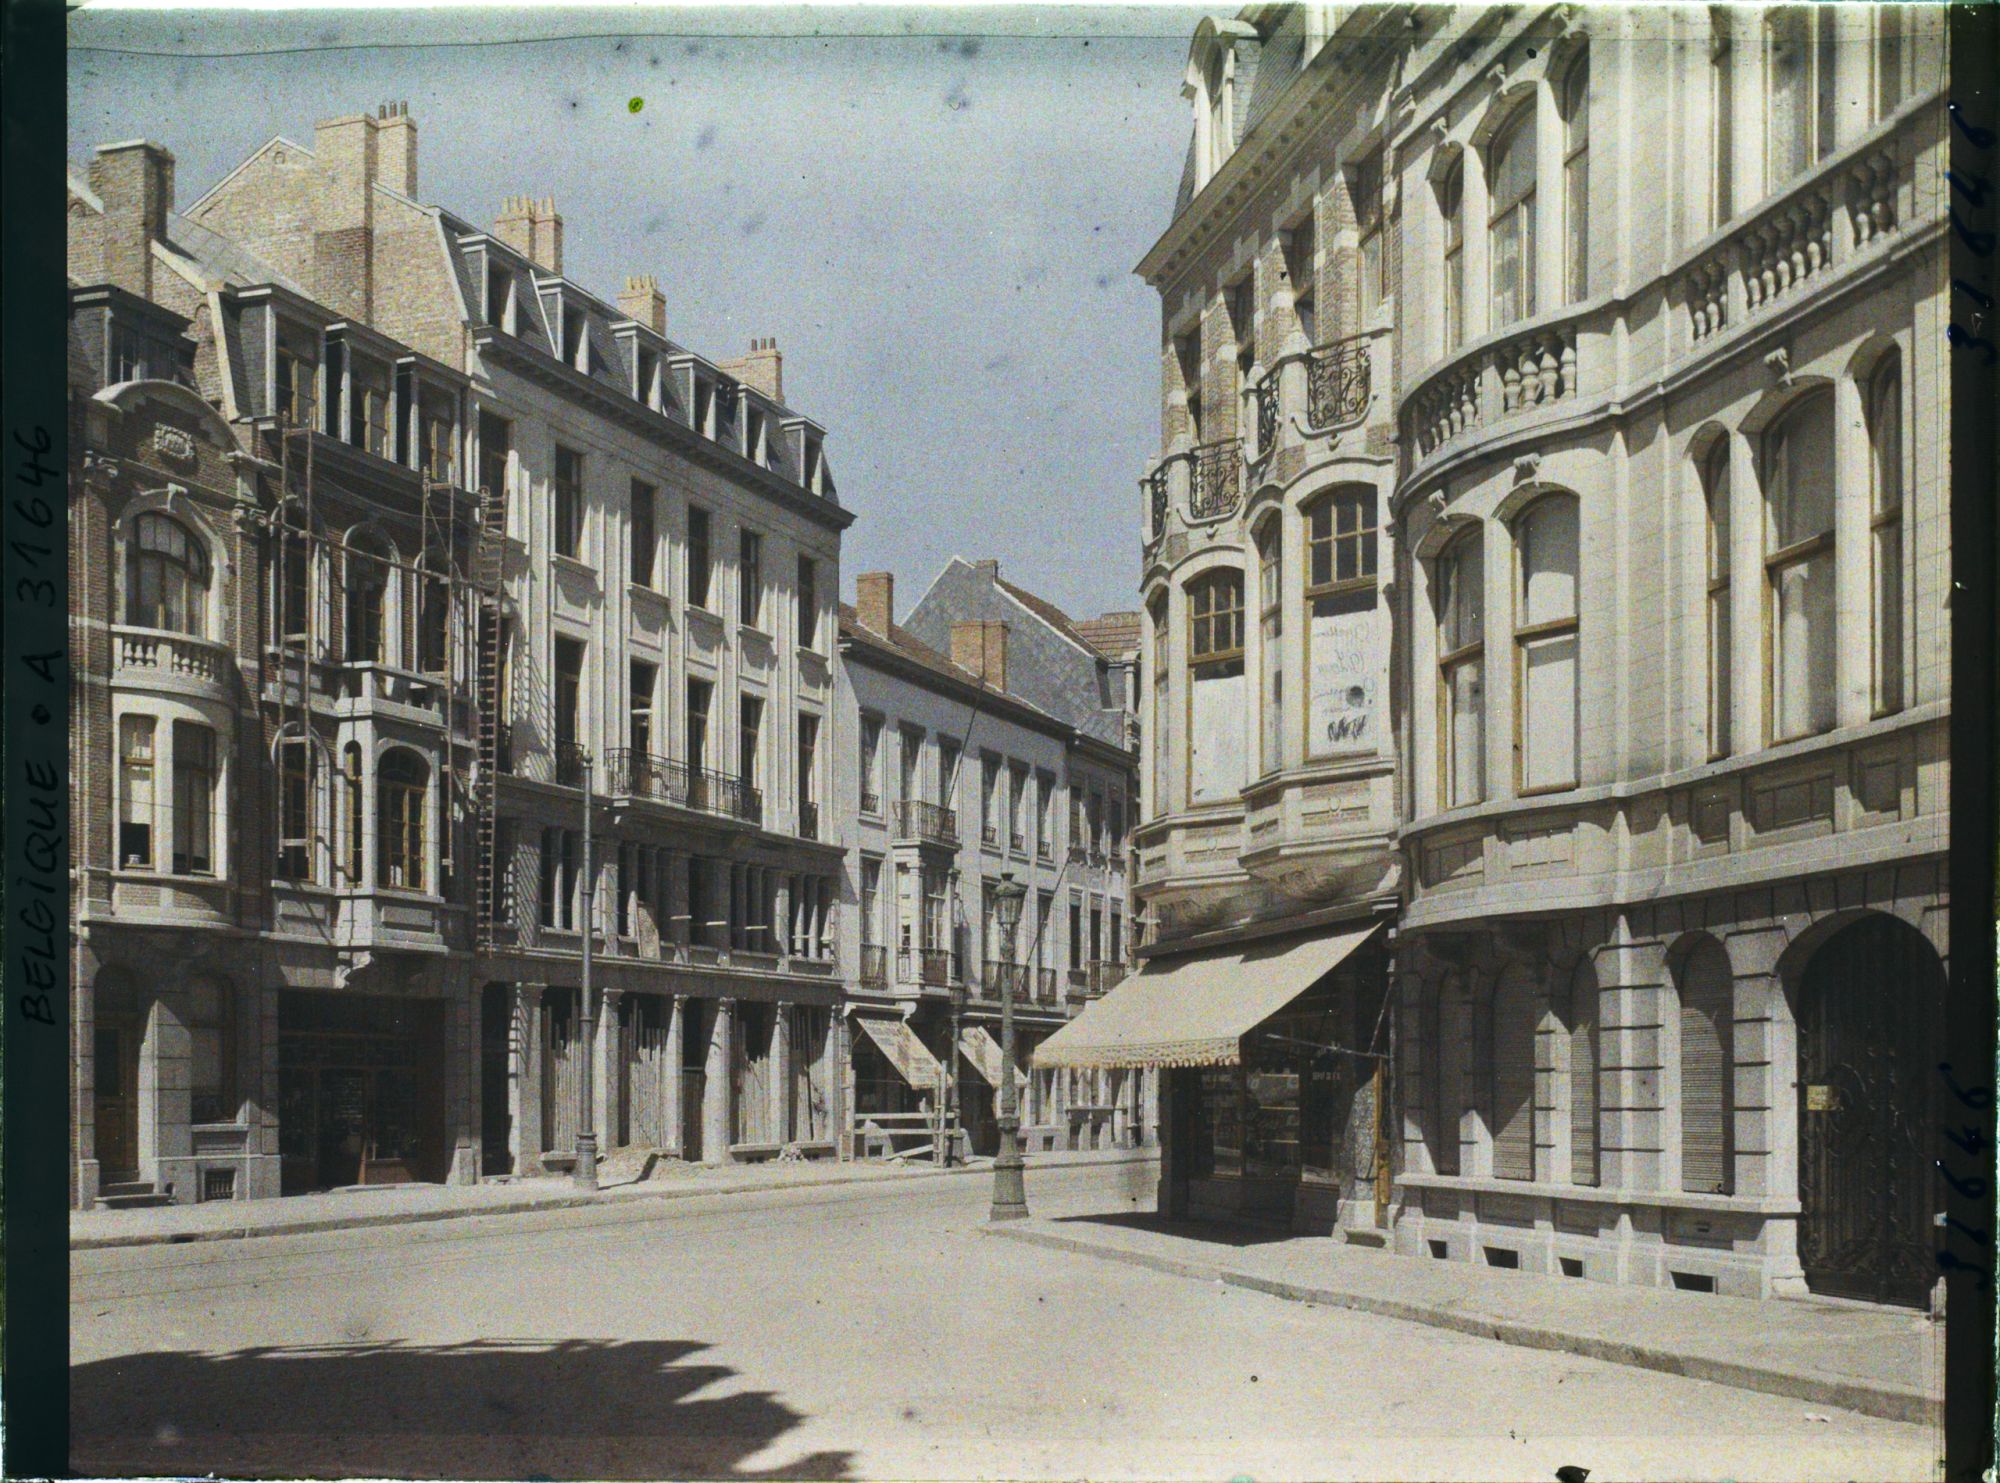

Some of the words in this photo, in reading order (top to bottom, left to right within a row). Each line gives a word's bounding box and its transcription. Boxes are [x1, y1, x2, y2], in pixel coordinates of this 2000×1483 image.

[12, 423, 61, 608] 31646
[21, 648, 63, 684] A
[16, 758, 59, 1026] BELGIQUE
